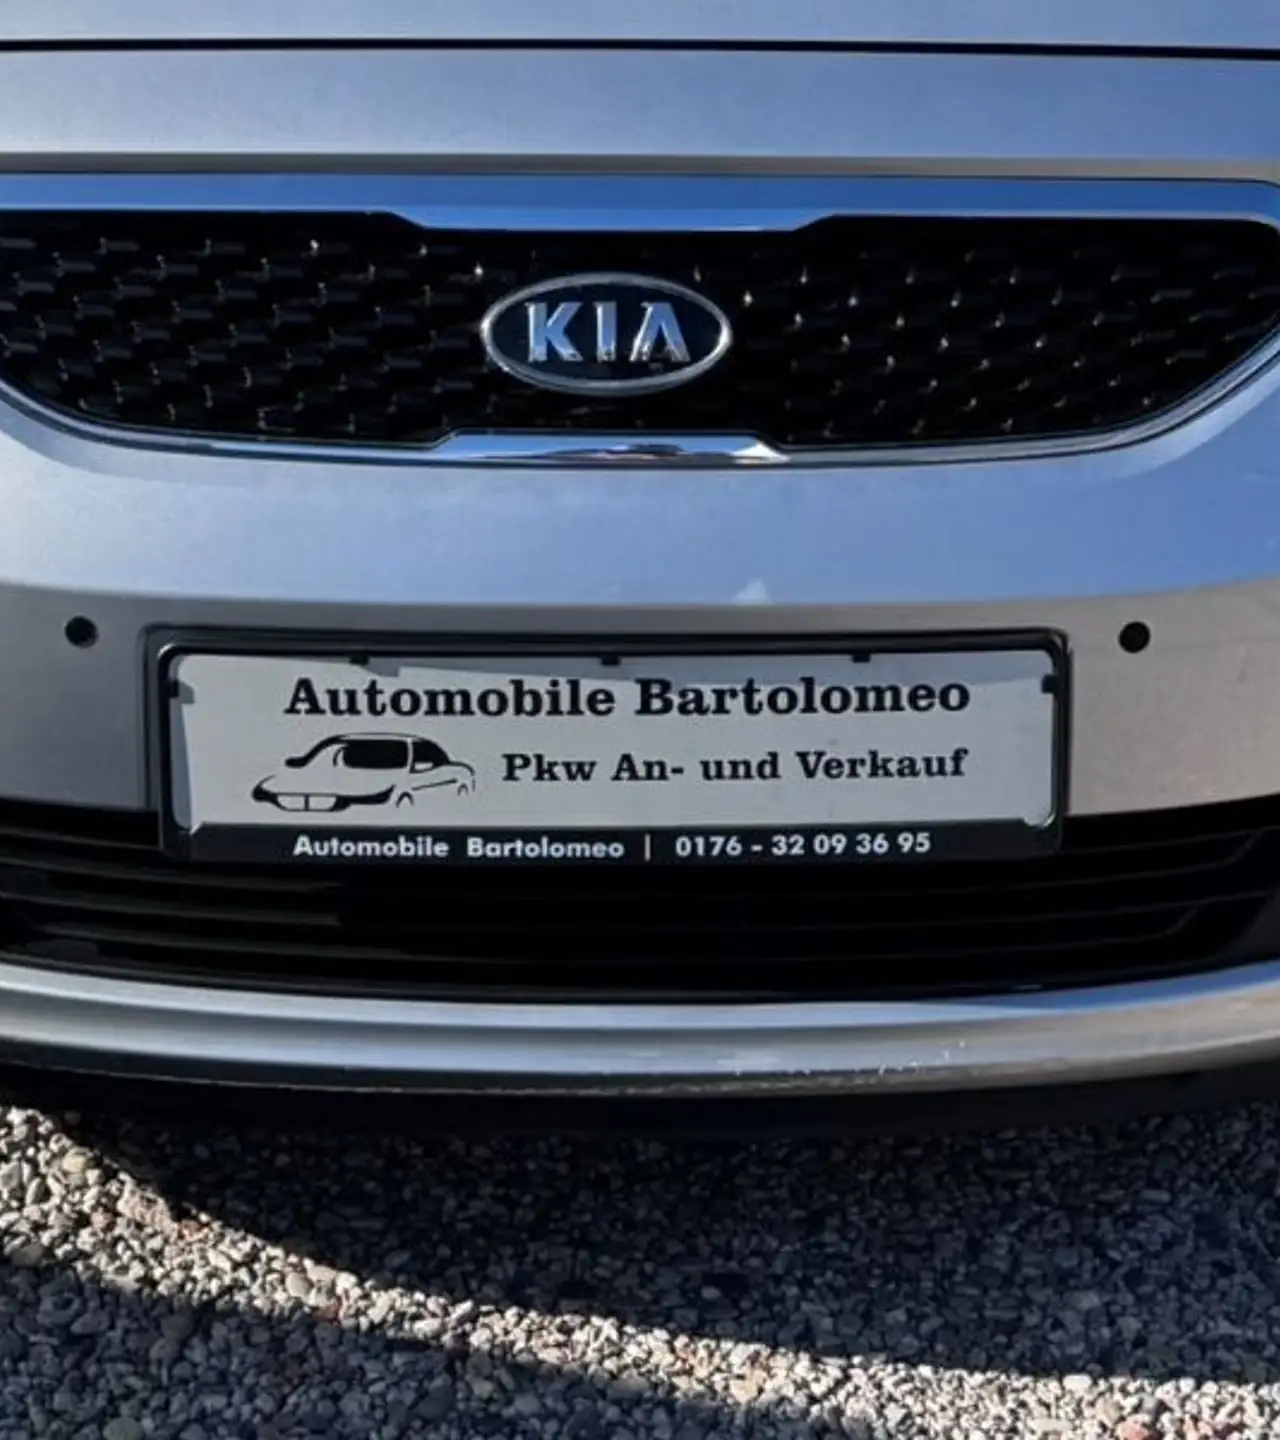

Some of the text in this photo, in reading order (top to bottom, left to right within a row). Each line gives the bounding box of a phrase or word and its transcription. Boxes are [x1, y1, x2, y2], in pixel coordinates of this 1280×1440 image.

[524, 300, 691, 363] KIA
[284, 675, 970, 716] Automobile Bartolomeo
[500, 746, 969, 782] Pkw An- und Verkauf
[292, 834, 449, 858] Automobile
[466, 836, 625, 859] Bartolomeo
[674, 835, 743, 858] 0176
[771, 834, 805, 856] 32
[813, 833, 847, 856] 09
[855, 833, 890, 855] 36
[897, 832, 932, 854] 95
